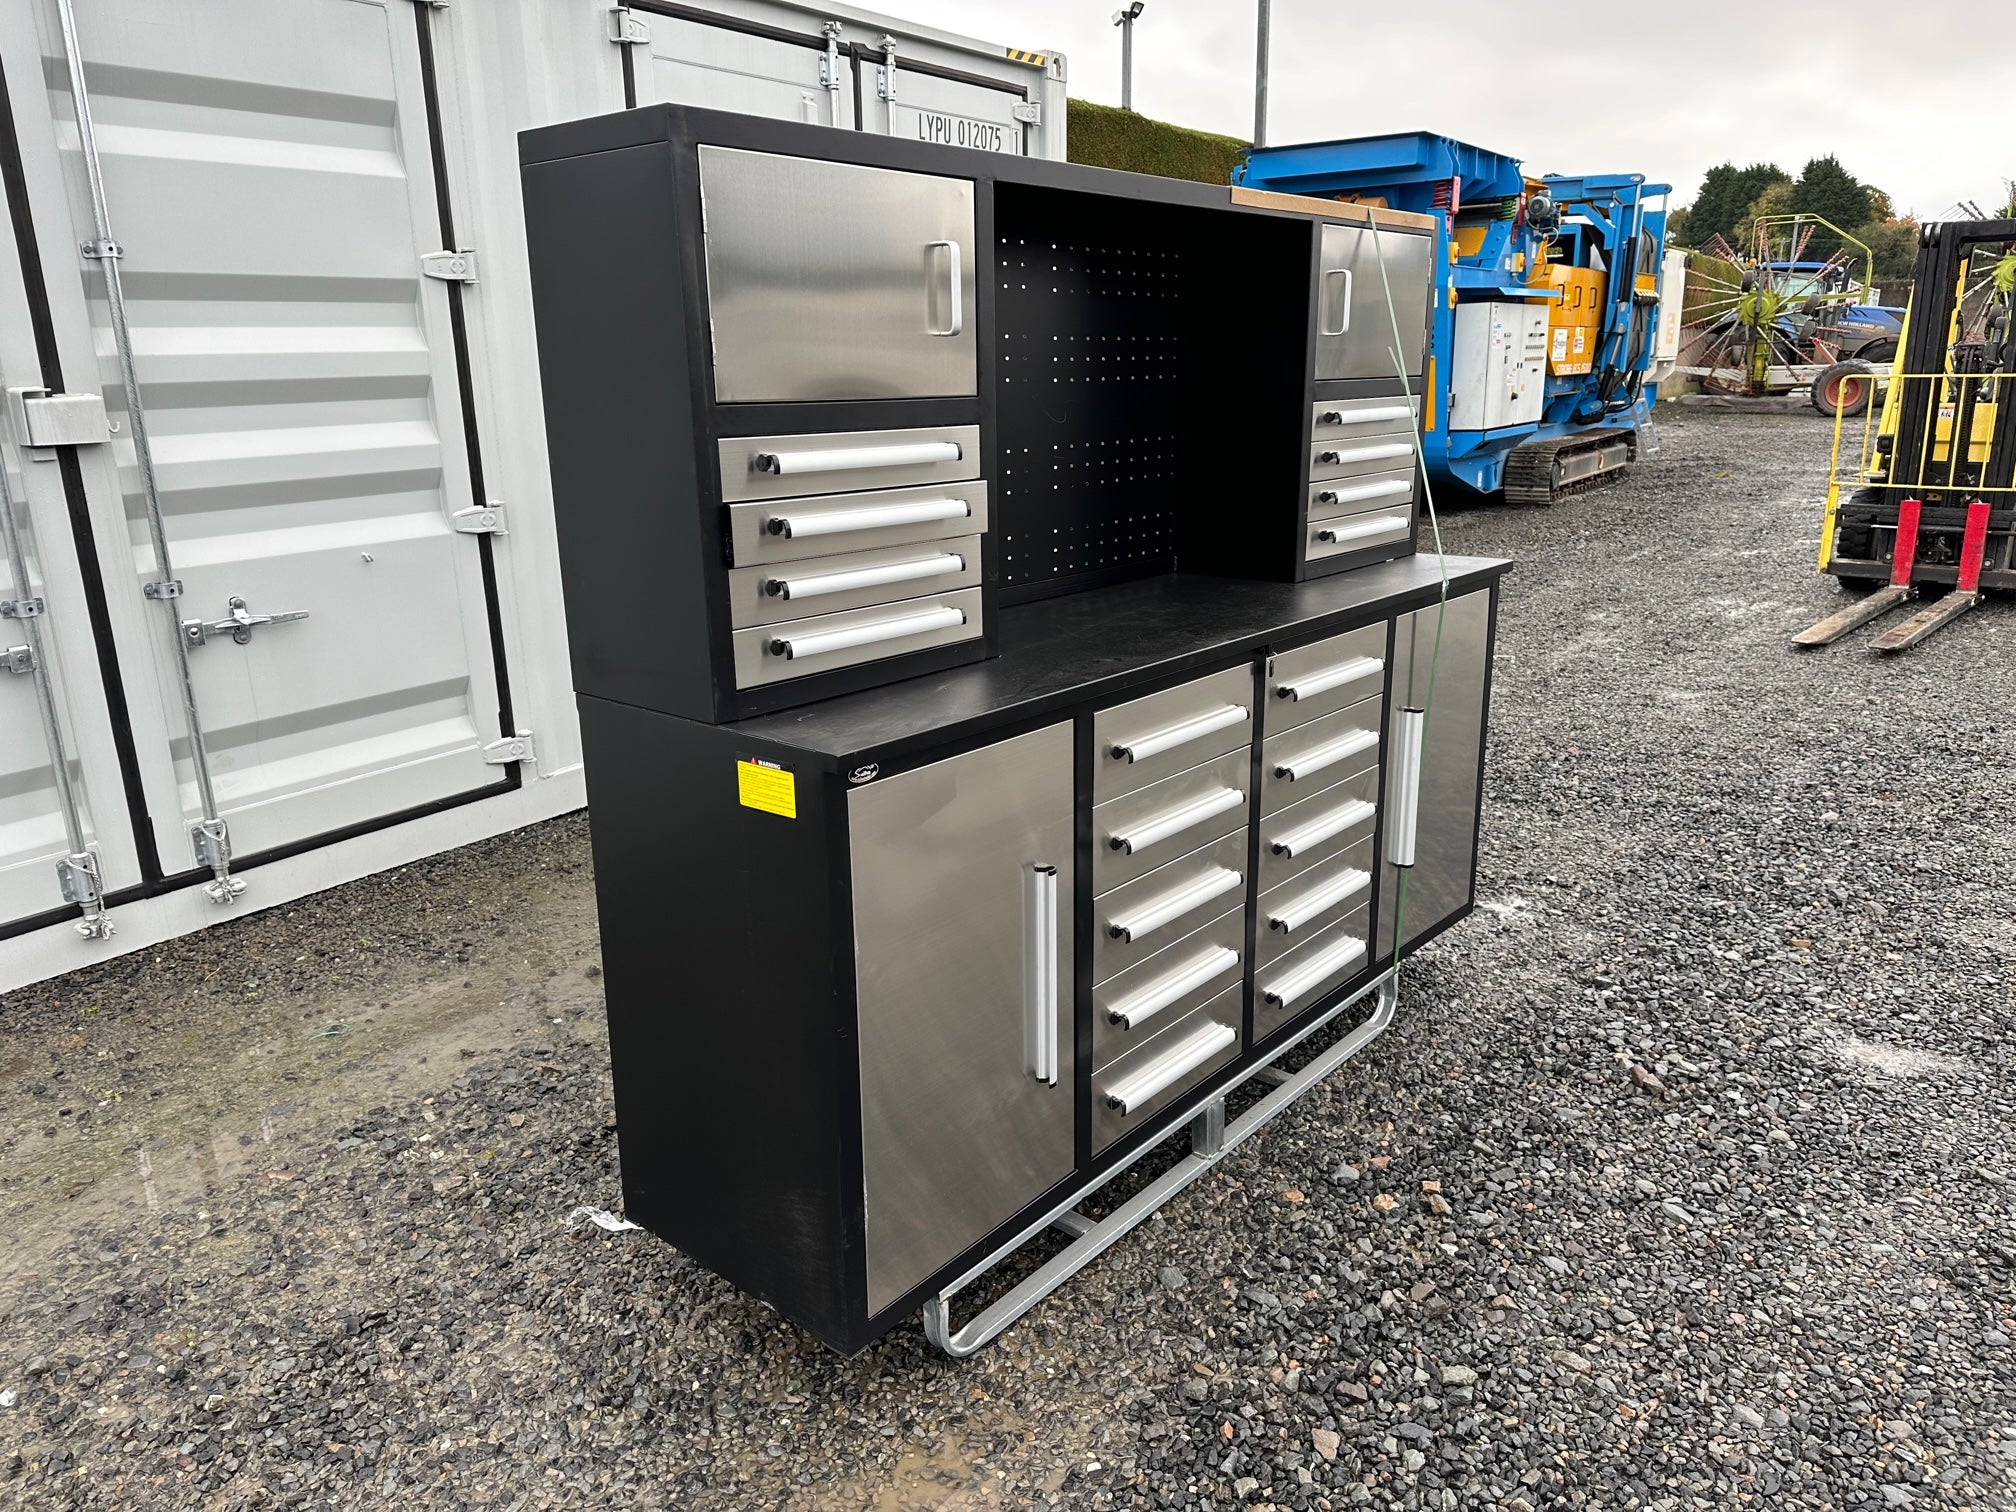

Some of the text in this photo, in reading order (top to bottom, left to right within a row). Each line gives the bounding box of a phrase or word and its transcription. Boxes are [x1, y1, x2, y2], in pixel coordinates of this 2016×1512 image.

[918, 113, 951, 144] LYPU
[957, 120, 1002, 152] 012075
[757, 759, 781, 770] WARNING
